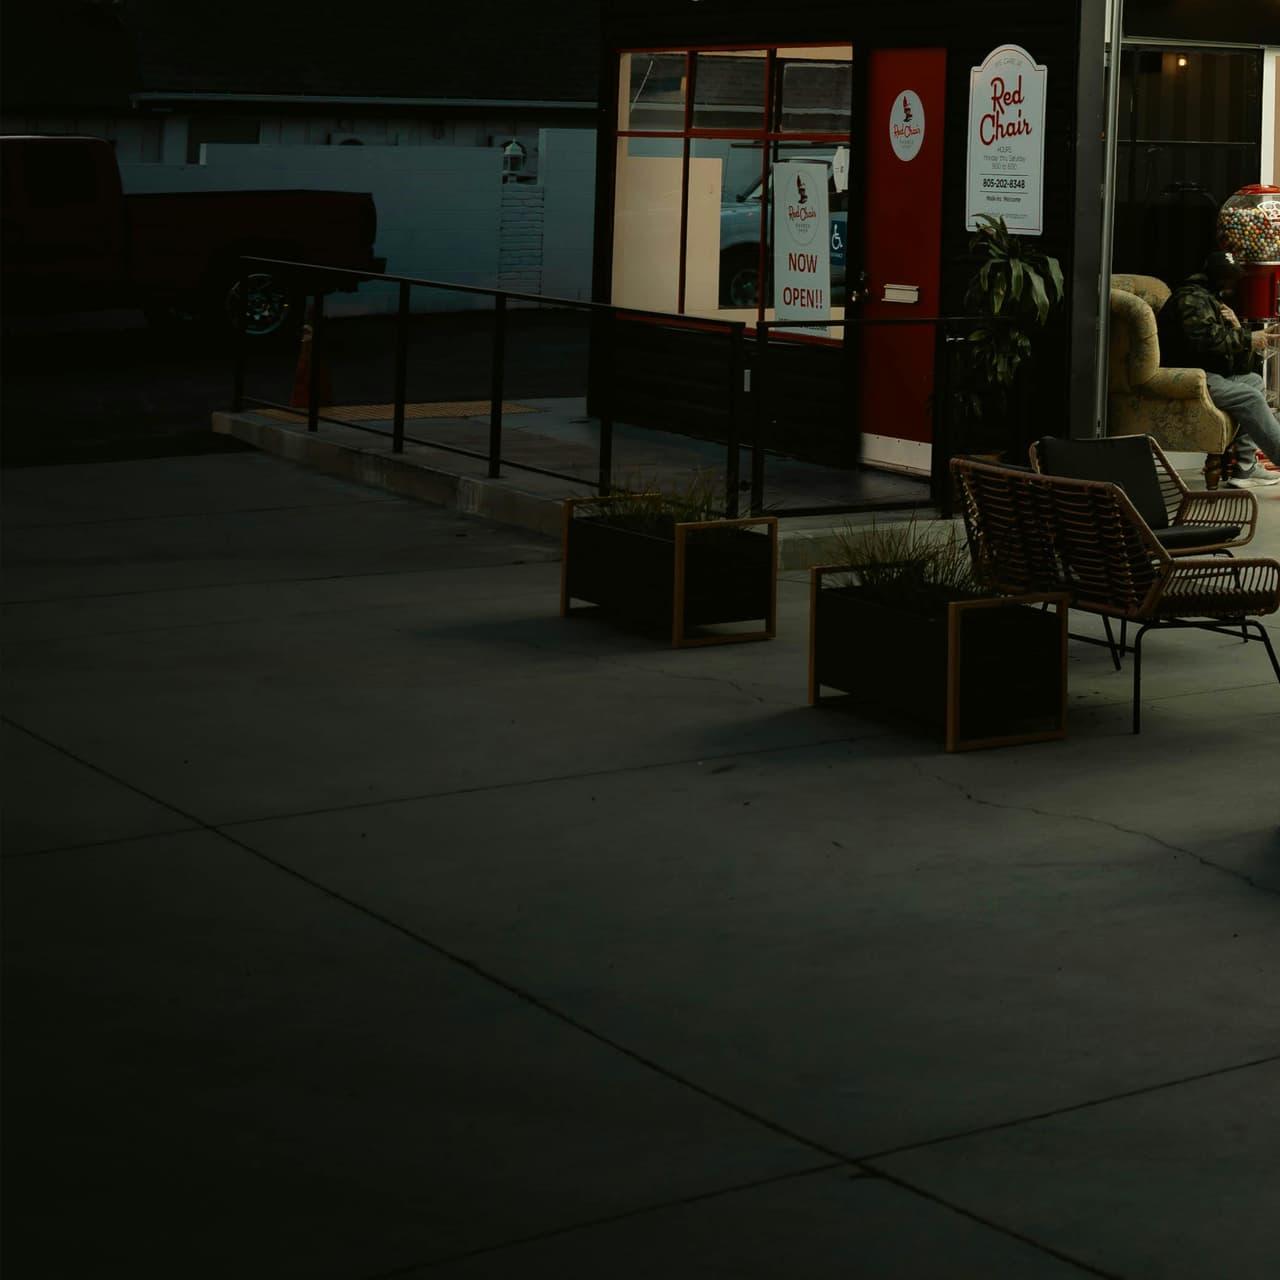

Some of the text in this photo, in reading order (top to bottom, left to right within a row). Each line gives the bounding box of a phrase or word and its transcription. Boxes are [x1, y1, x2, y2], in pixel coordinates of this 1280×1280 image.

[990, 74, 1025, 115] Red
[980, 109, 1033, 146] Chair
[983, 178, 1026, 189] 805-202-8348
[787, 252, 818, 273] NOW
[783, 287, 823, 309] OPEN!!
